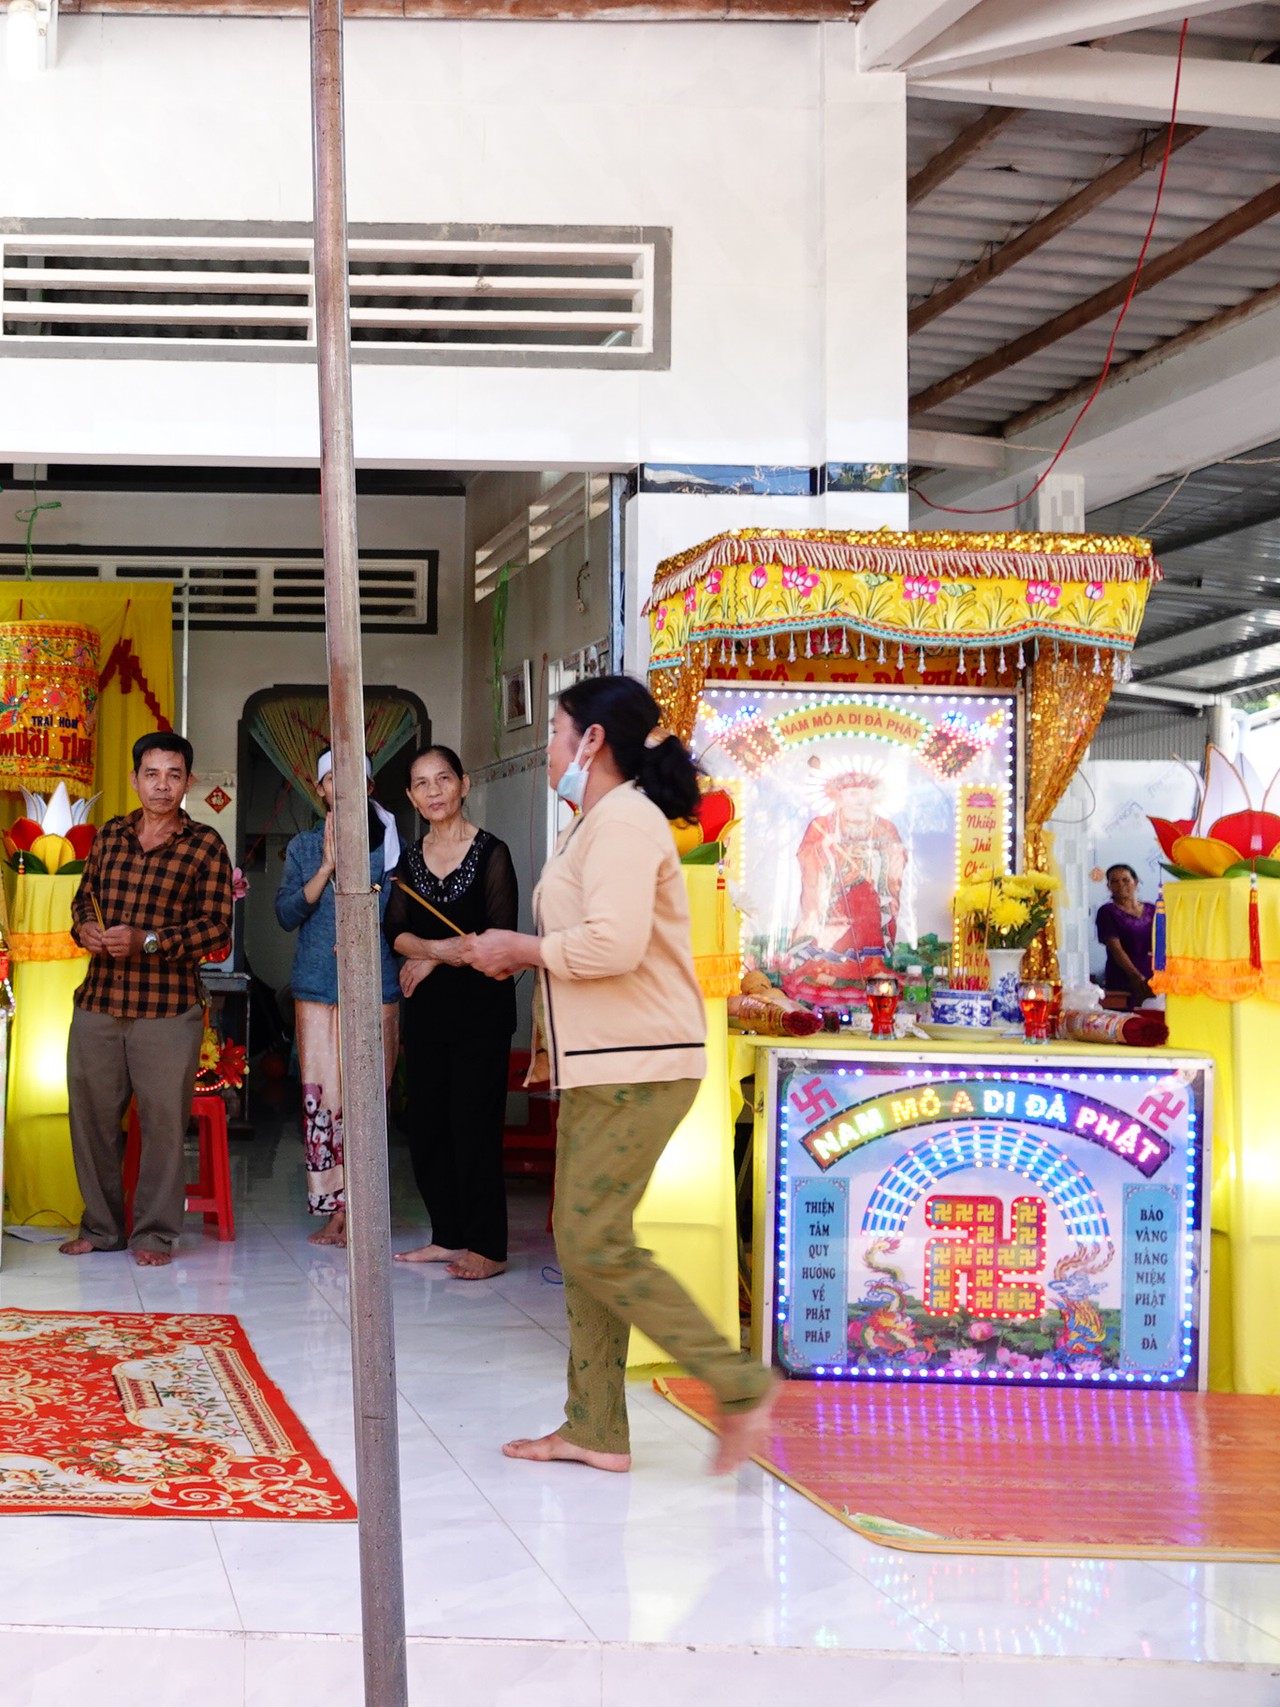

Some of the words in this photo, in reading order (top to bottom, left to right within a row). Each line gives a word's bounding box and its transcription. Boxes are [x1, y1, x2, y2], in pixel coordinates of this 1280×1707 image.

[780, 719, 809, 736] NAM
[812, 712, 832, 727] MÔ
[836, 713, 845, 724] A
[849, 713, 861, 724] DI
[813, 1107, 885, 1160] NAM
[891, 1087, 941, 1123] MÔ
[952, 1090, 974, 1114] A
[983, 1089, 1015, 1114] DI
[1075, 1106, 1161, 1164] PHẬT
[805, 1199, 835, 1217] THIỆN
[808, 1244, 829, 1259] QUY
[1143, 1313, 1156, 1327] DI
